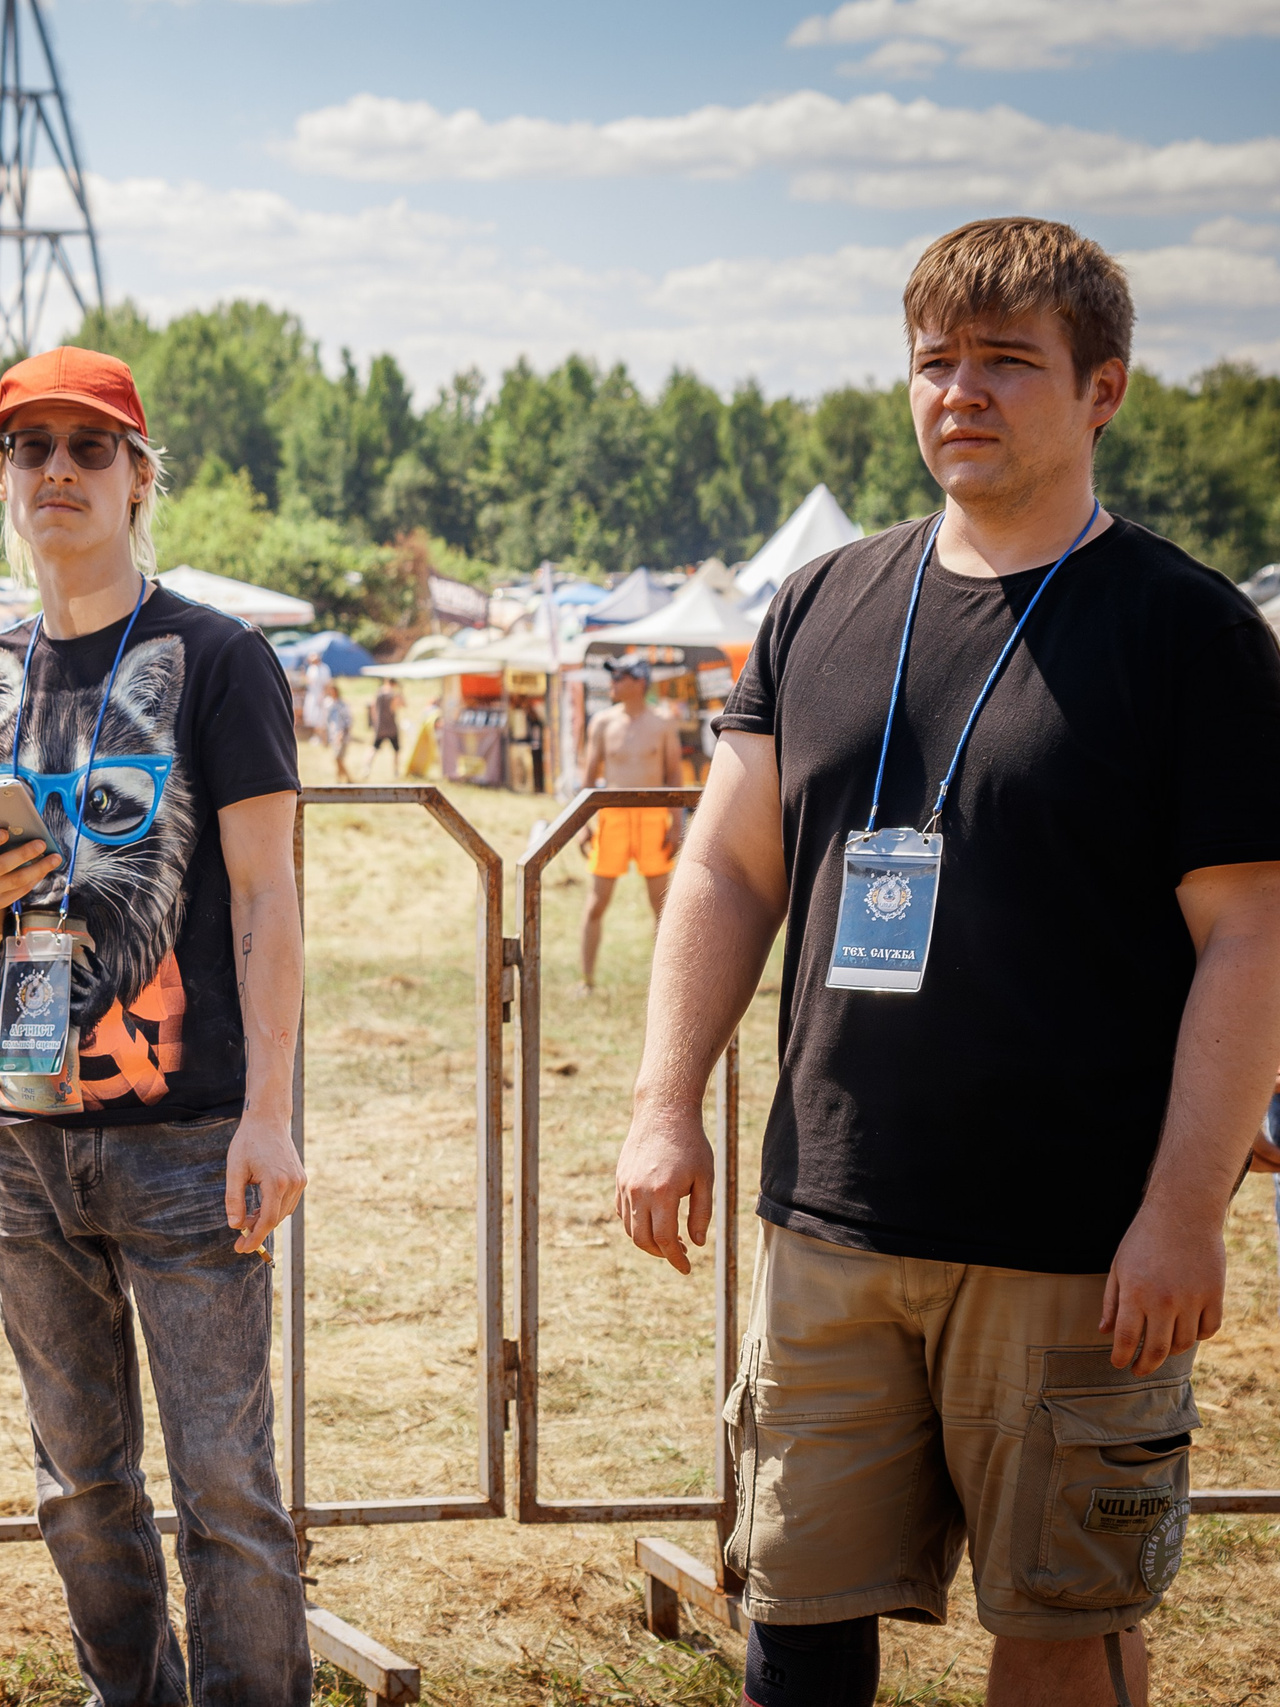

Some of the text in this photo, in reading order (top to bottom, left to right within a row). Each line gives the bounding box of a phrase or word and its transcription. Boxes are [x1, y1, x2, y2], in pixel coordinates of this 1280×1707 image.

[870, 947, 916, 961] СЛУЖБА
[9, 1023, 55, 1037] АРТИСТ
[1097, 1495, 1171, 1517] VILLAINS
[1145, 1535, 1160, 1580] YAKUZA
